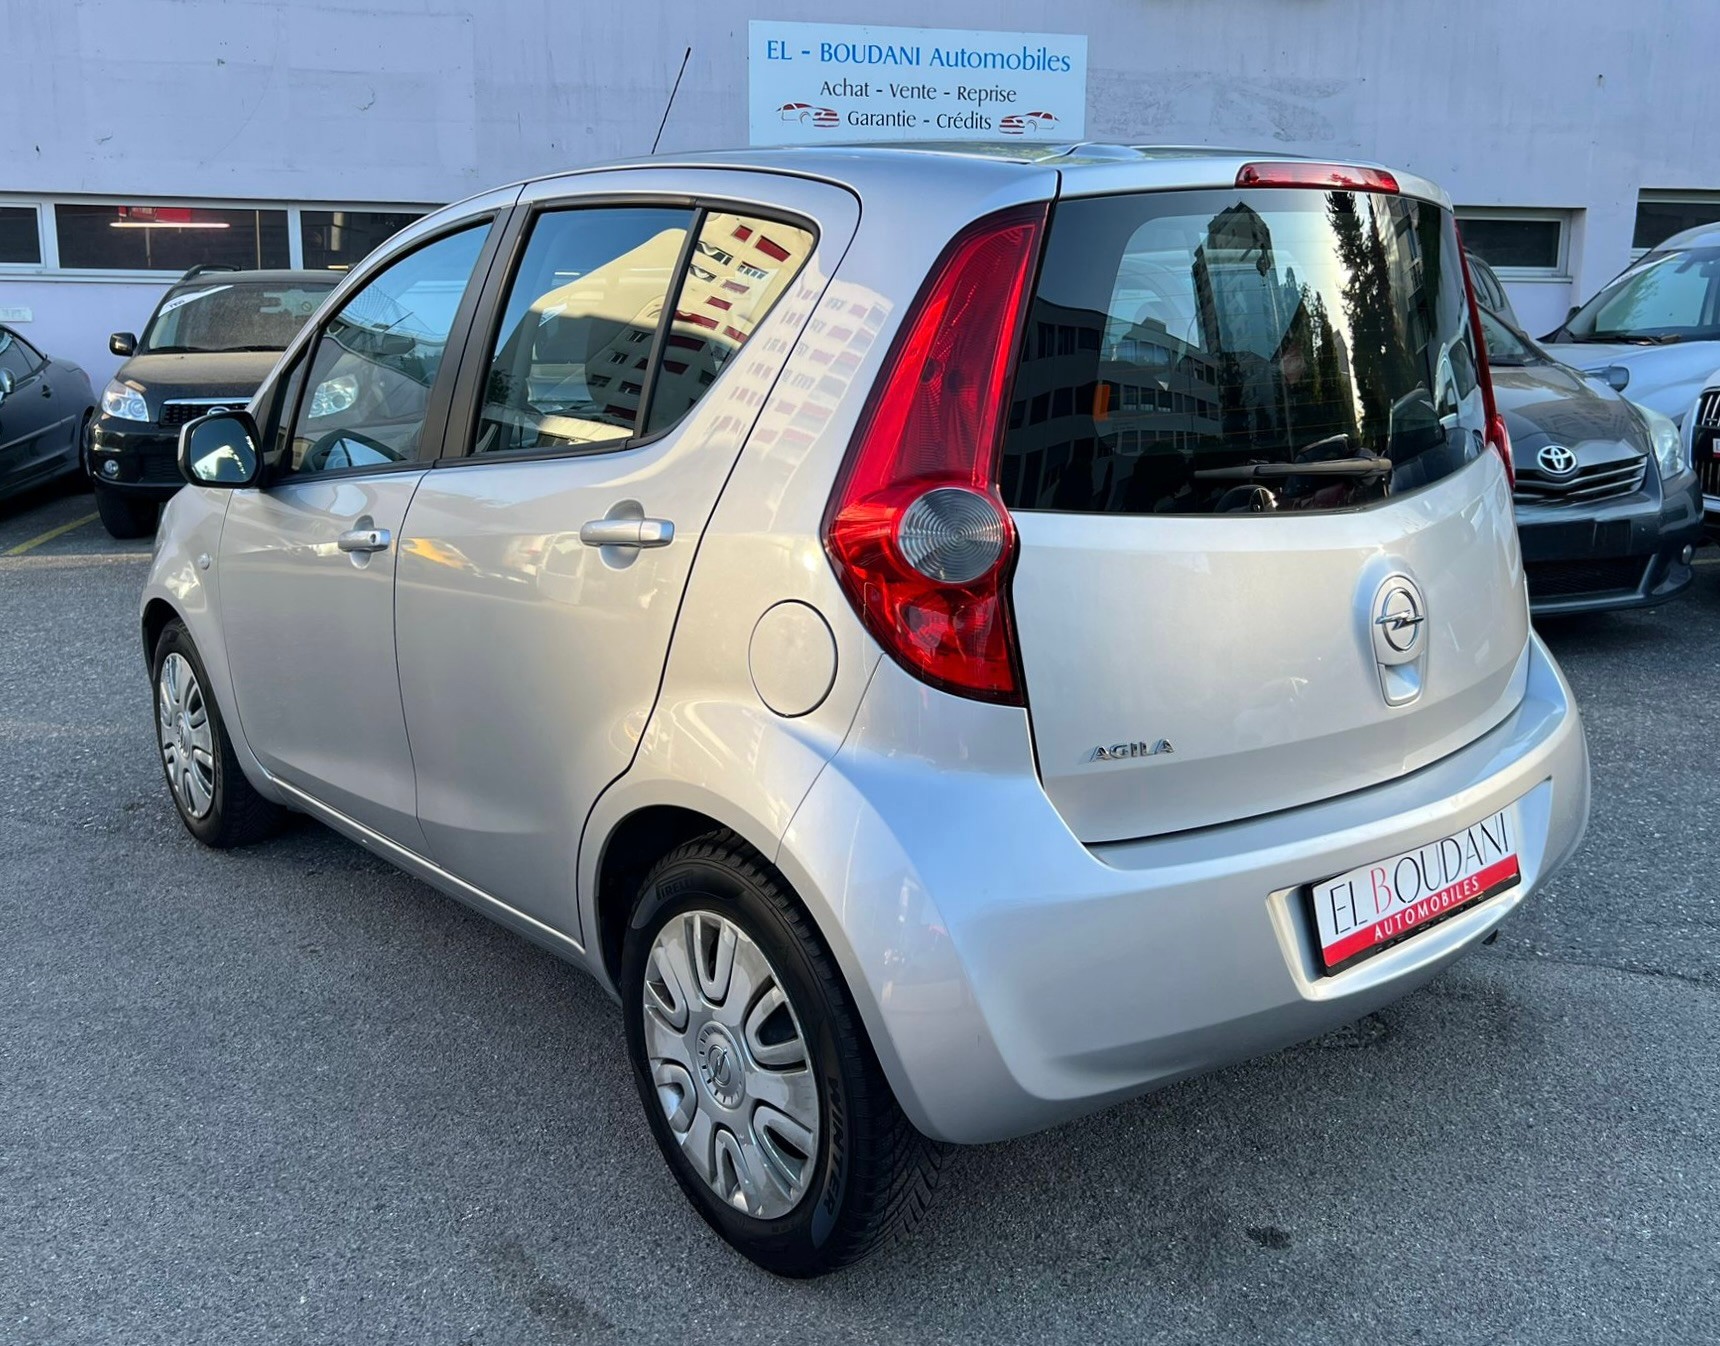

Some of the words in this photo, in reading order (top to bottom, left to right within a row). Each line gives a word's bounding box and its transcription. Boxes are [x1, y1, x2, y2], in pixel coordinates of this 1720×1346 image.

[766, 39, 793, 61] EL
[820, 42, 921, 66] BOUDANI
[929, 47, 1071, 72] Automobiles
[820, 78, 870, 97] Achat
[889, 83, 937, 100] Vente
[957, 85, 1017, 107] Reprise
[847, 110, 916, 128] Garantie
[936, 112, 991, 130] Crédits
[1089, 738, 1175, 762] AGILA
[1329, 881, 1368, 935] EL
[1370, 812, 1509, 914] BOUDANI
[1374, 876, 1480, 941] AUTOMOBILES
[824, 1076, 844, 1215] WINTER
